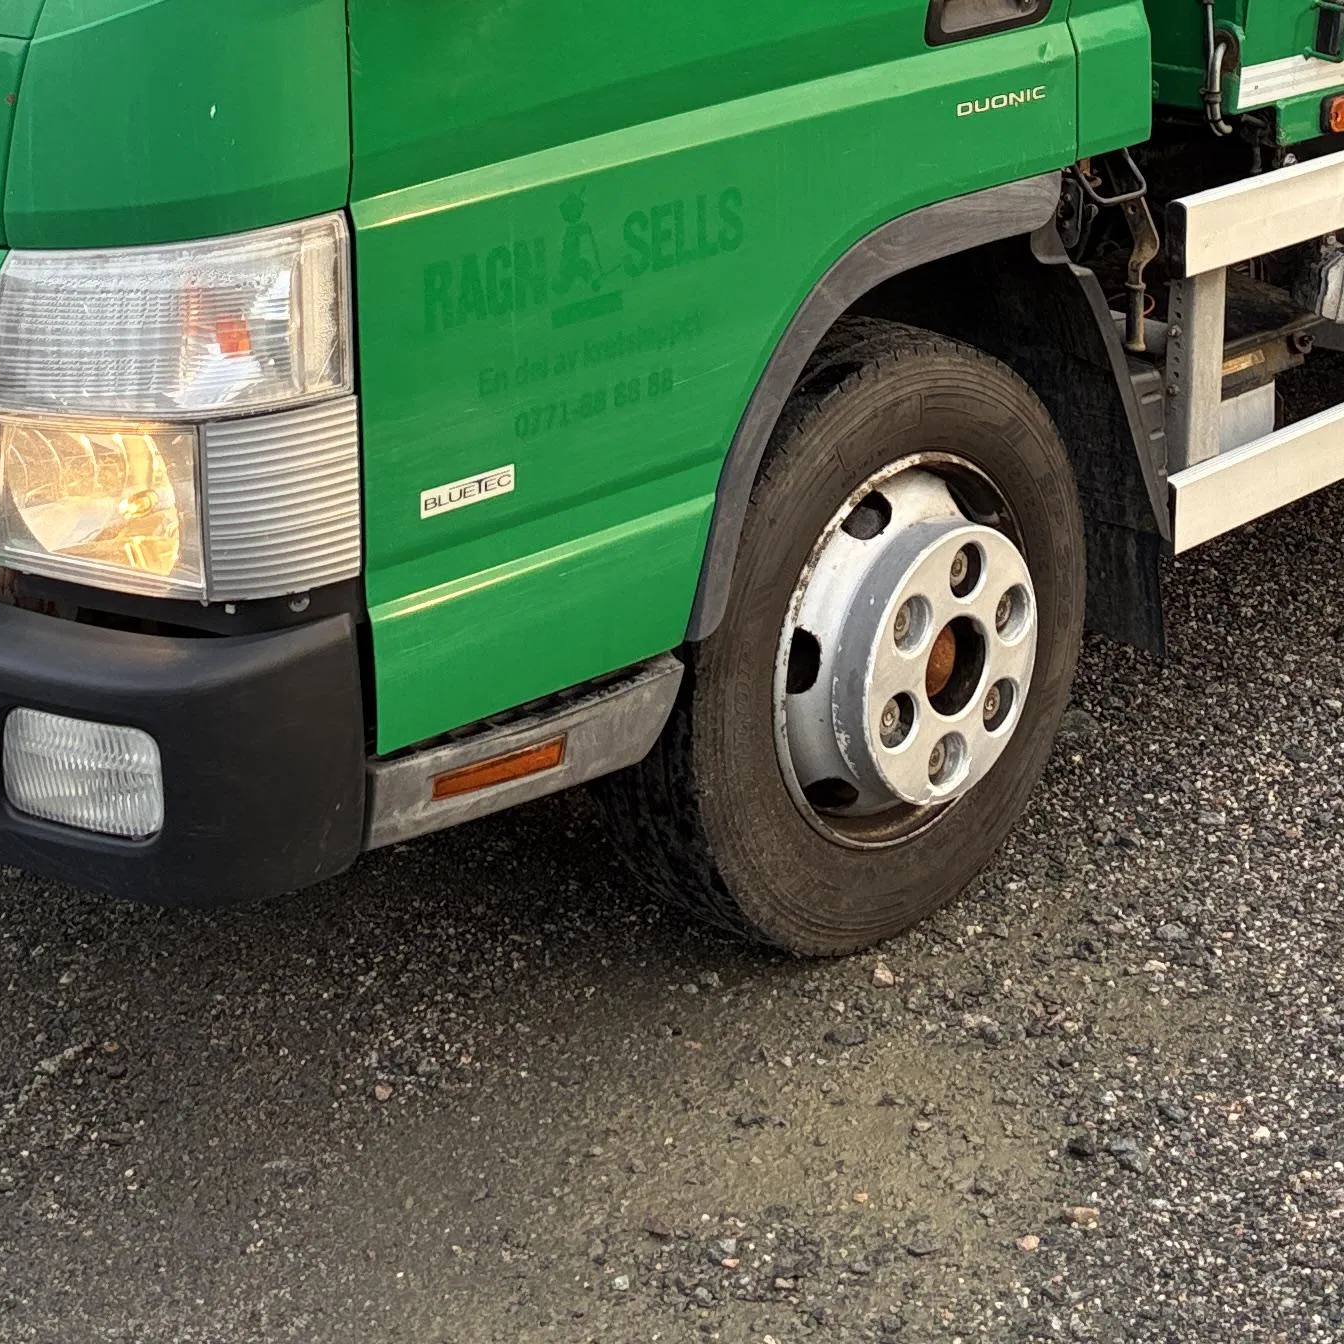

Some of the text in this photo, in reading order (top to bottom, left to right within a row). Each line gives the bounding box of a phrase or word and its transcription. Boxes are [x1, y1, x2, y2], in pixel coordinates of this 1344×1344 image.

[957, 85, 1046, 117] DUONIC
[422, 186, 745, 335] RAGN SELLS
